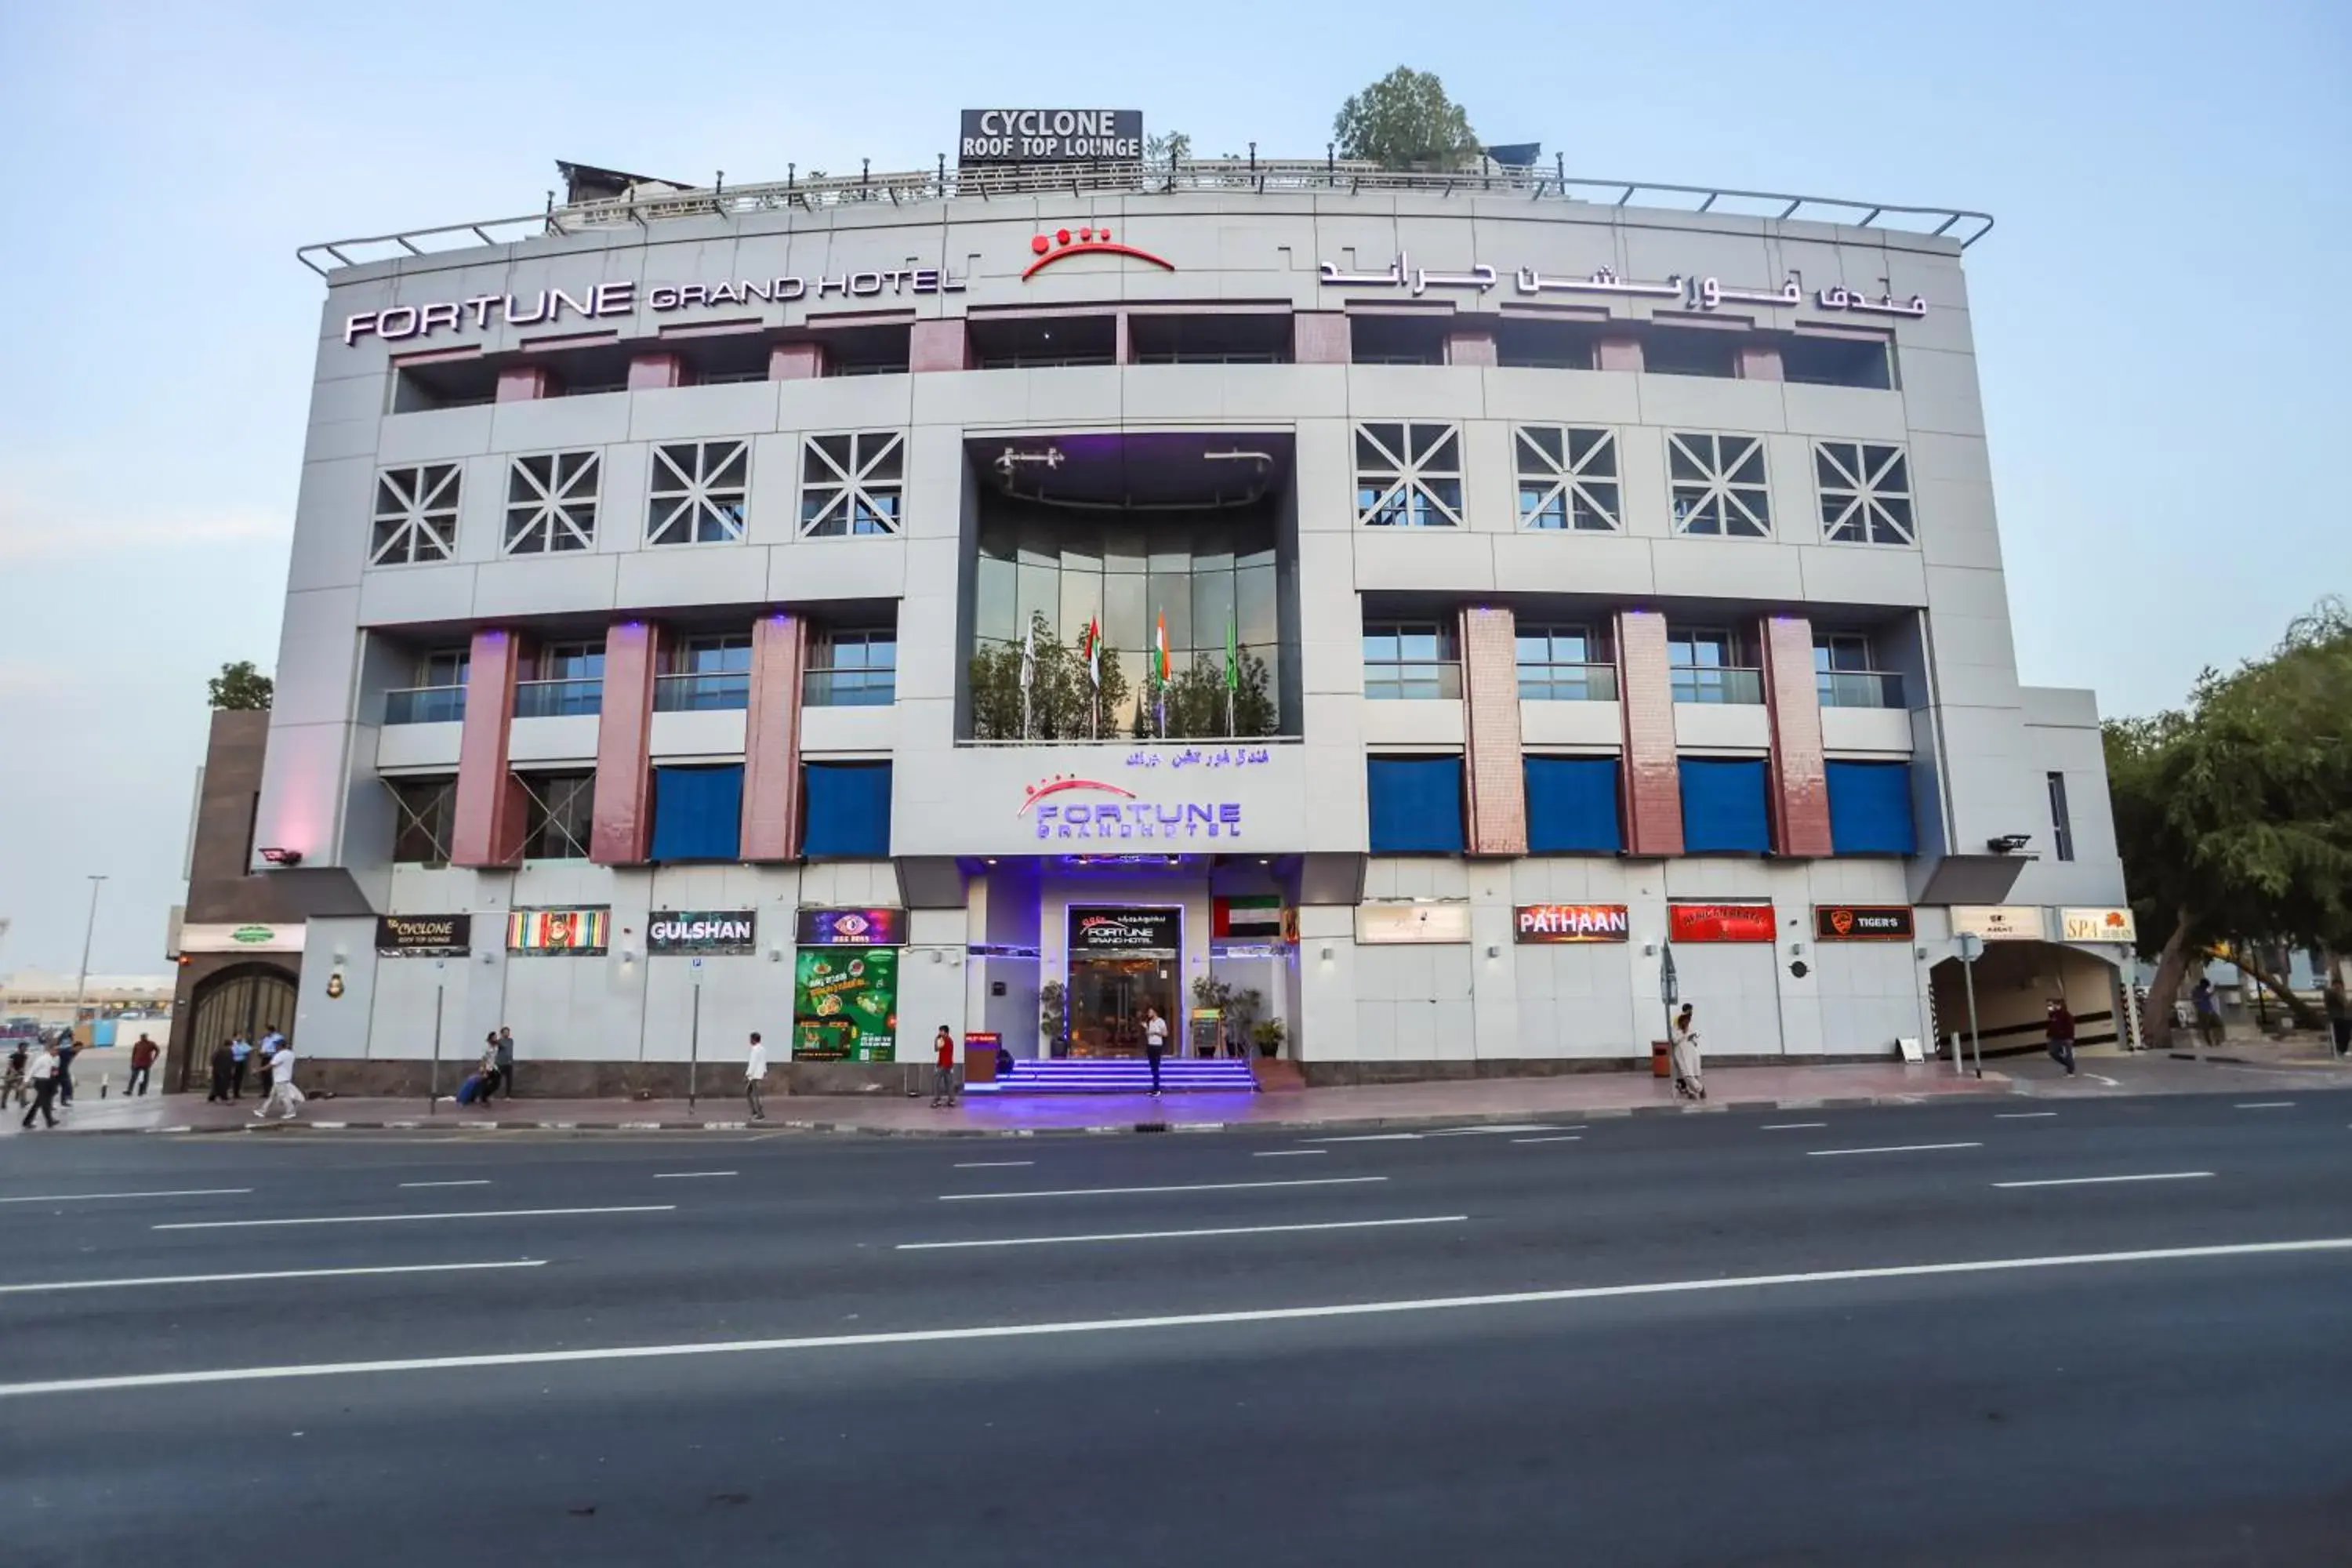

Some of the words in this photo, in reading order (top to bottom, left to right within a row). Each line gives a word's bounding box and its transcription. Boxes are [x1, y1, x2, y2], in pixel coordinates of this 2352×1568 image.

[981, 111, 1116, 136] CYCLONE
[963, 137, 1014, 156] ROOF
[1020, 137, 1058, 156] TOP
[1065, 138, 1139, 156] LOUNGE
[344, 281, 635, 346] FORTUNE
[648, 277, 804, 310] GRAND
[817, 269, 966, 297] HOTEL
[1036, 804, 1240, 823] FORTUNE
[397, 921, 454, 935] CYCLONE
[651, 921, 750, 939] GULSHAN
[1520, 911, 1625, 932] PATHAAN
[2067, 920, 2097, 938] SPA
[1087, 927, 1153, 937] FORTUNE
